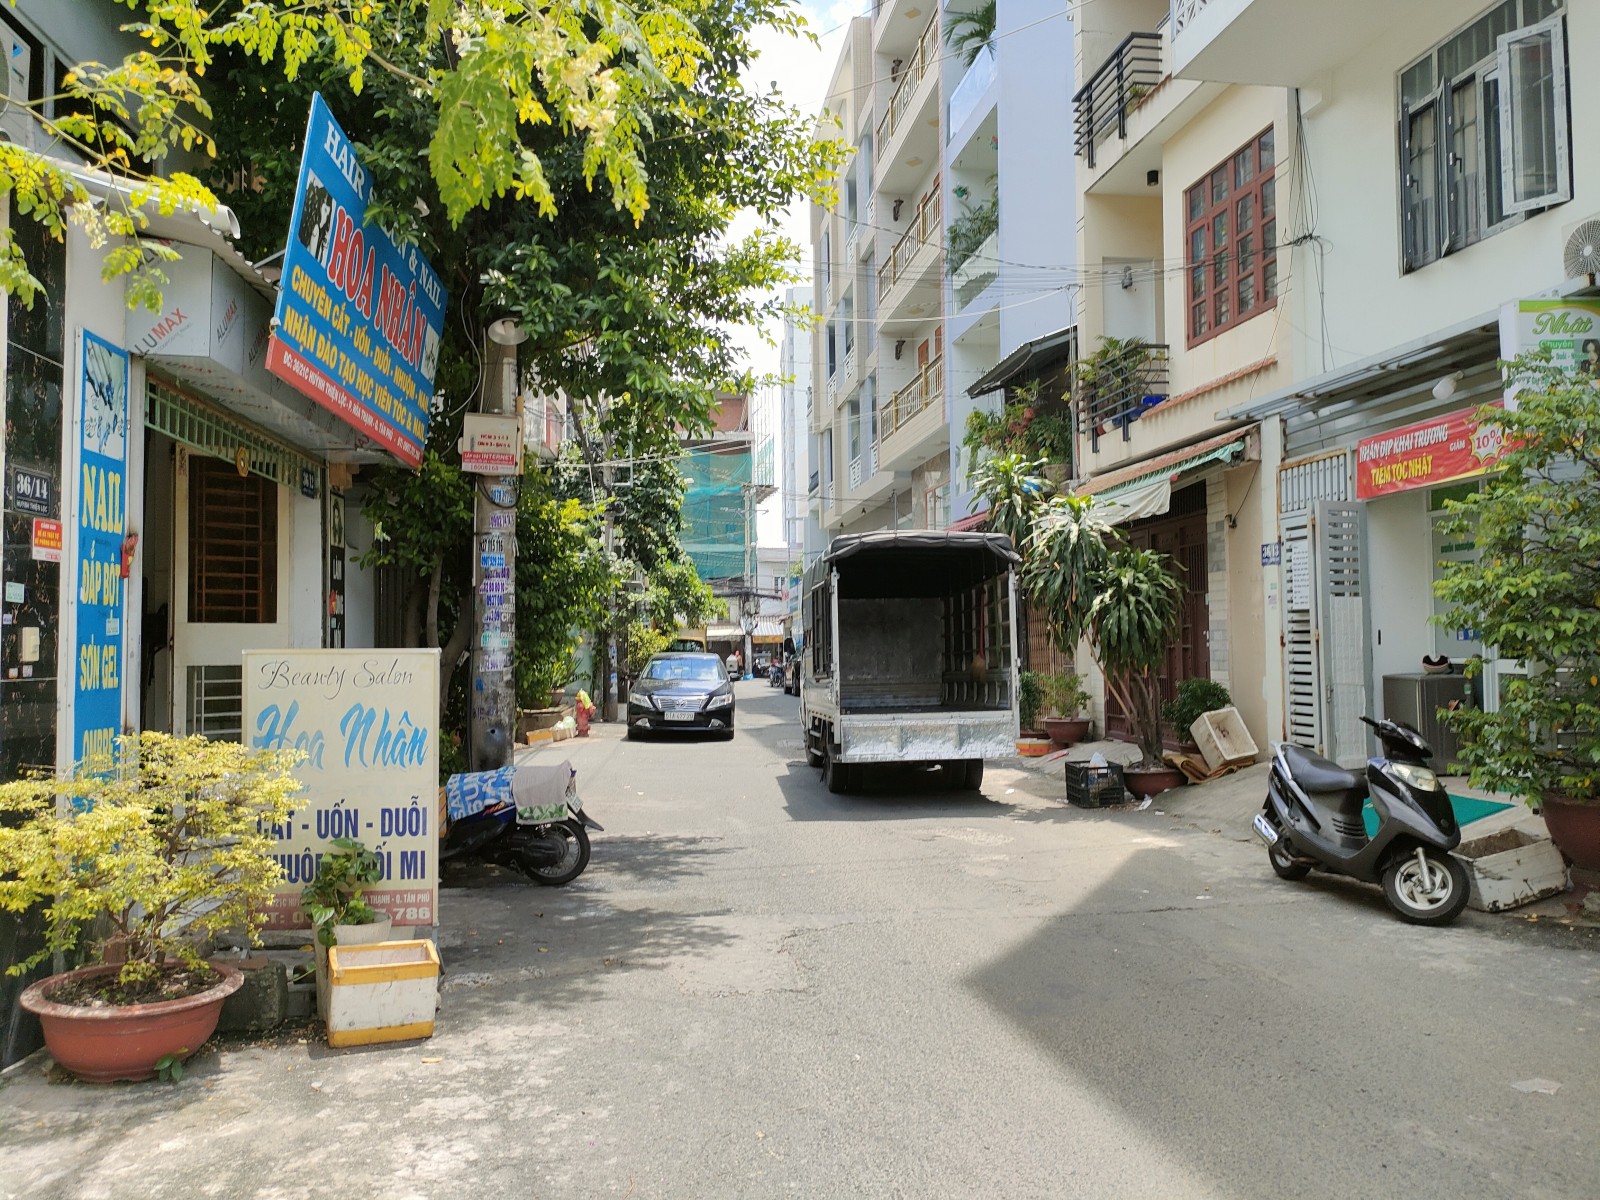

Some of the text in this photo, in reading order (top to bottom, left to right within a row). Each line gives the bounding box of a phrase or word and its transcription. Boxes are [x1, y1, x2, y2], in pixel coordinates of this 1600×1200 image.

[324, 120, 365, 200] HAIR
[327, 205, 375, 320] HOA
[373, 263, 427, 372] NHÂN
[419, 261, 442, 311] NAIL
[216, 297, 238, 344] ALUMAX
[291, 264, 333, 321] CHUYÊN
[331, 301, 351, 337] CẮT
[353, 325, 371, 358] UỐN
[1532, 311, 1594, 338] Nhật
[283, 303, 318, 353] NHẬN
[315, 331, 338, 370] ĐÀO
[338, 351, 357, 386] TẠO
[355, 367, 374, 401] HỌC
[373, 381, 393, 415] VIÊN
[392, 397, 407, 427] TÓC
[1359, 439, 1380, 464] NHÂN
[1393, 433, 1414, 455] KHAI
[1413, 423, 1449, 449] TRƯƠNG
[1475, 429, 1503, 449] 10%
[16, 473, 48, 500] 36/14
[1371, 452, 1433, 488] TIỆM TÓC NHẬT
[82, 462, 123, 534] NAIL
[101, 644, 119, 690] GEL
[257, 657, 414, 700] Beauty Salon
[252, 699, 429, 770] Hoa Nhân
[316, 798, 358, 840] UỐN
[380, 795, 428, 838] DUỖI
[400, 850, 426, 880] MI
[403, 891, 417, 903] TÂN
[417, 890, 430, 902] PHÚ
